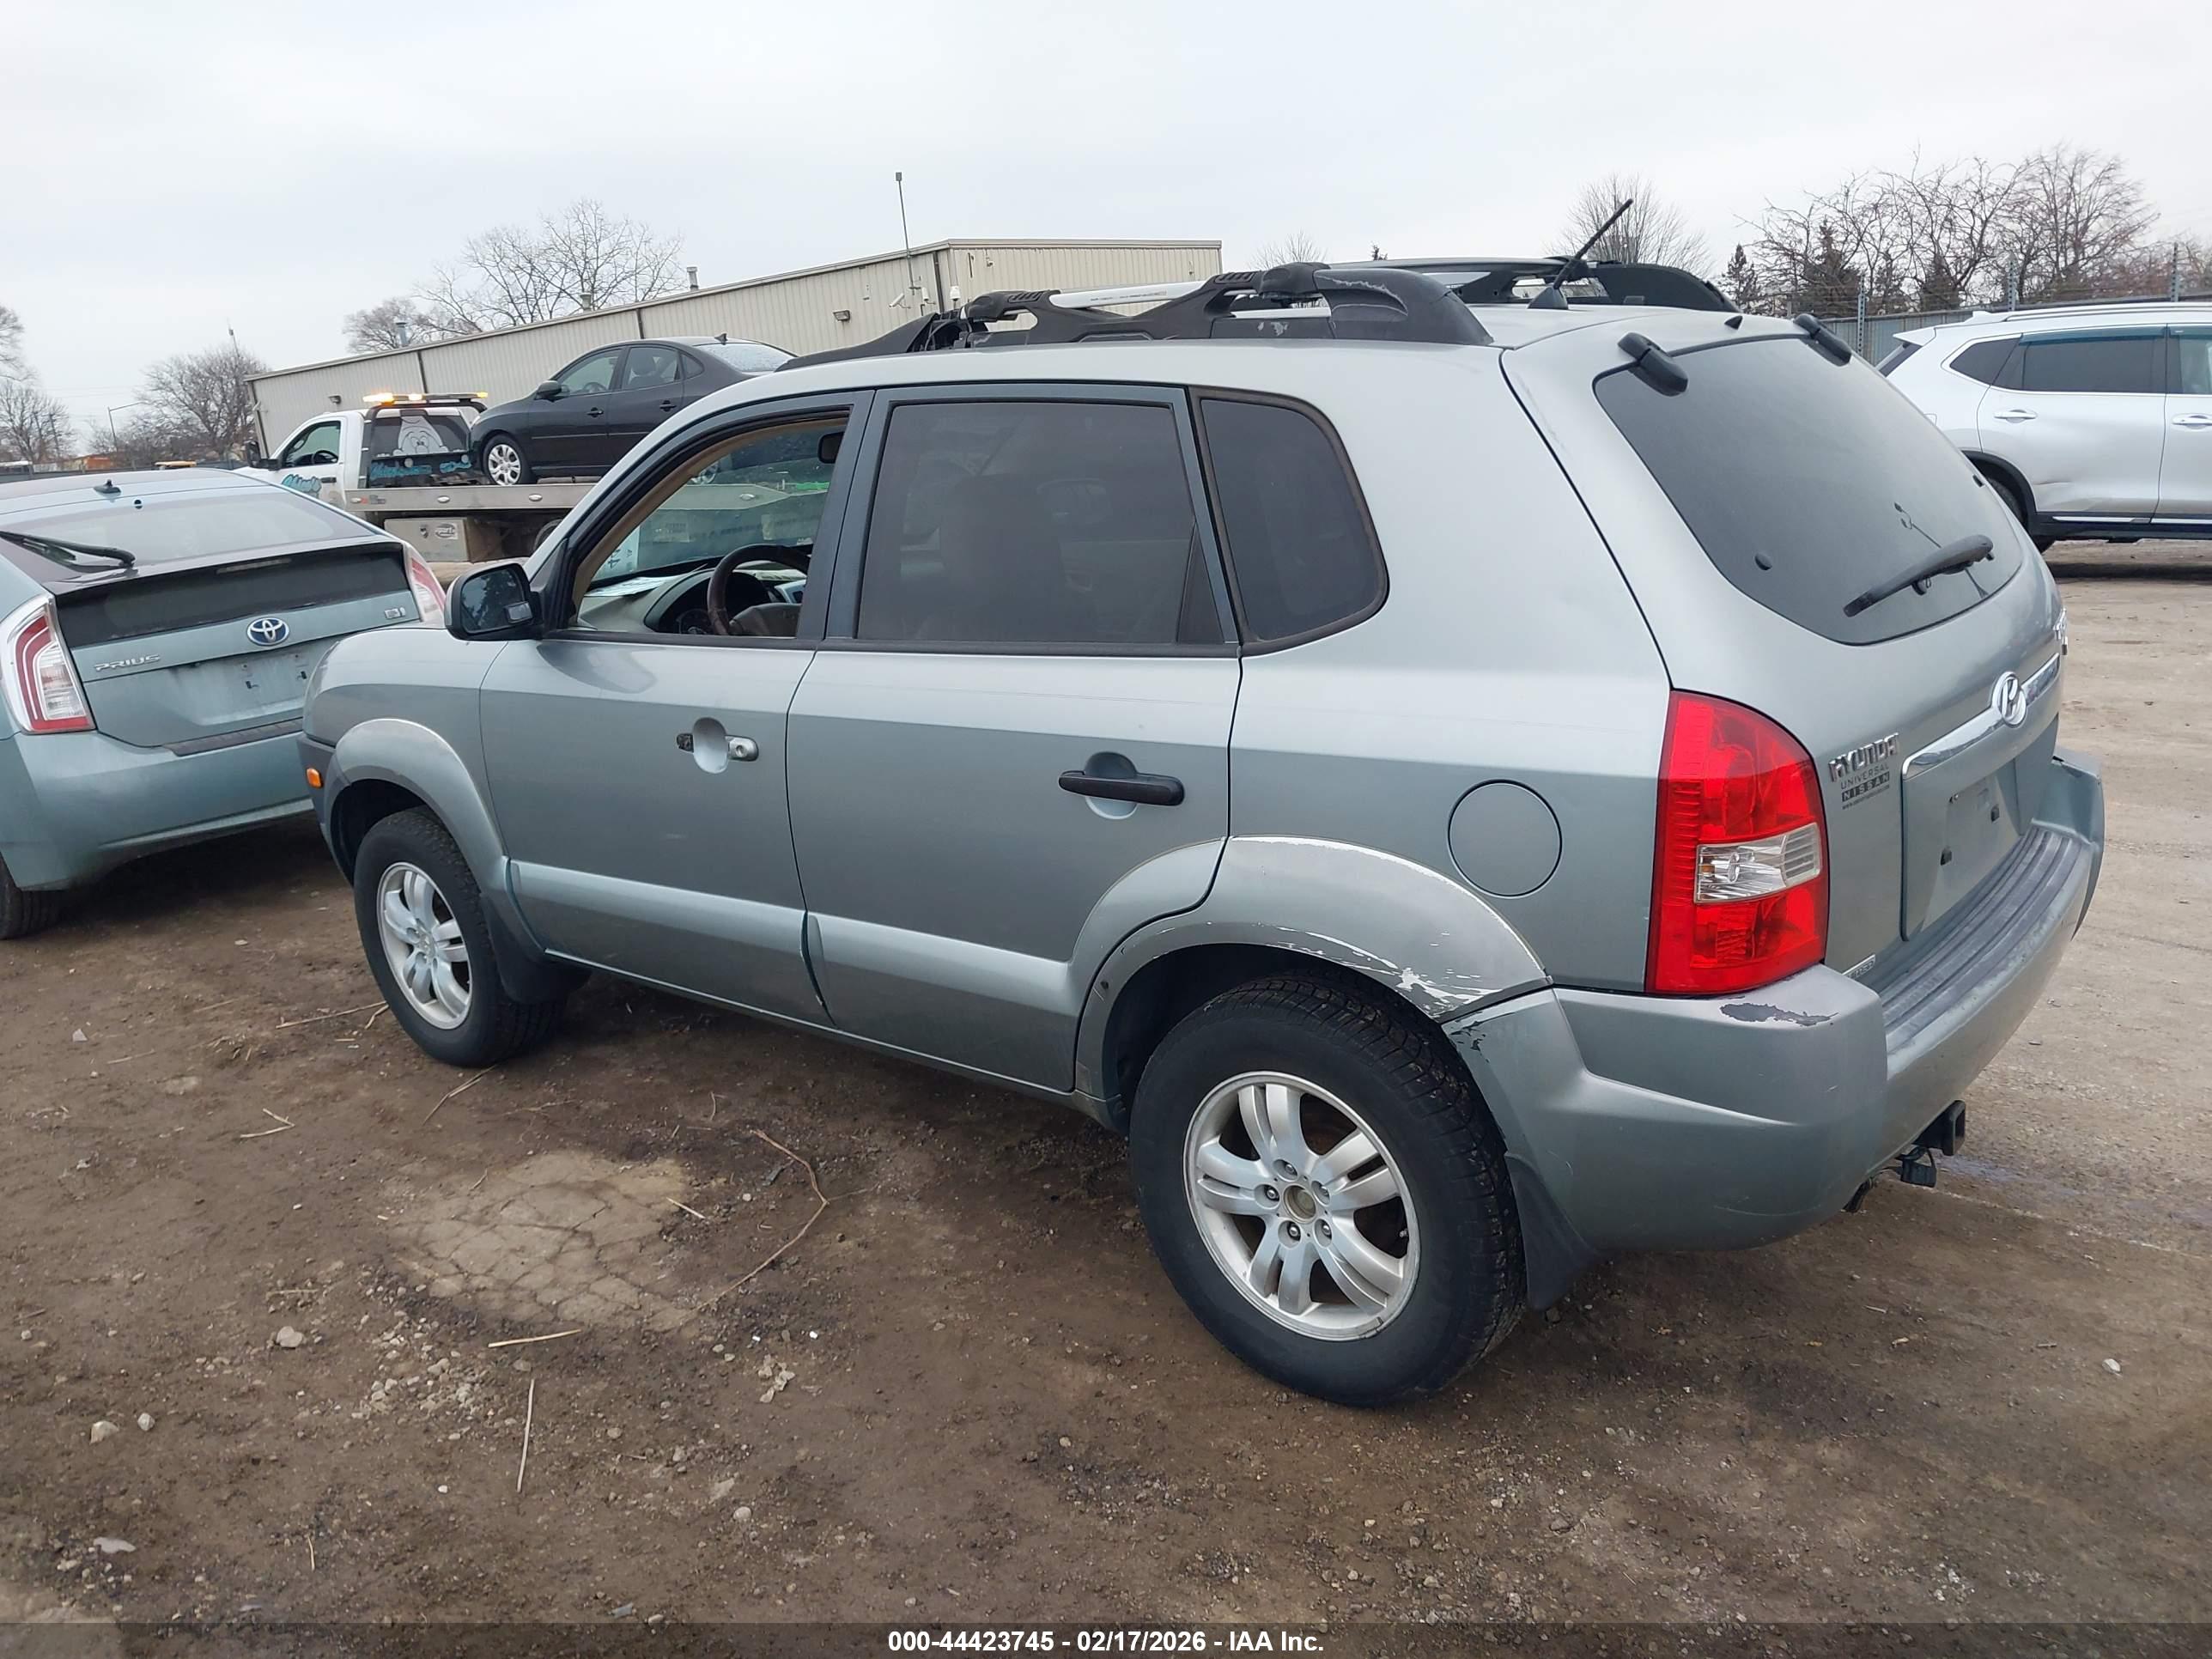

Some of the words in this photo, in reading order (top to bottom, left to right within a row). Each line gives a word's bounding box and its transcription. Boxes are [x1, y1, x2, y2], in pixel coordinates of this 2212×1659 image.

[94, 653, 161, 672] PRIUS
[1840, 762, 1889, 790] UNIVERSAL
[1841, 771, 1890, 802] NISSAN
